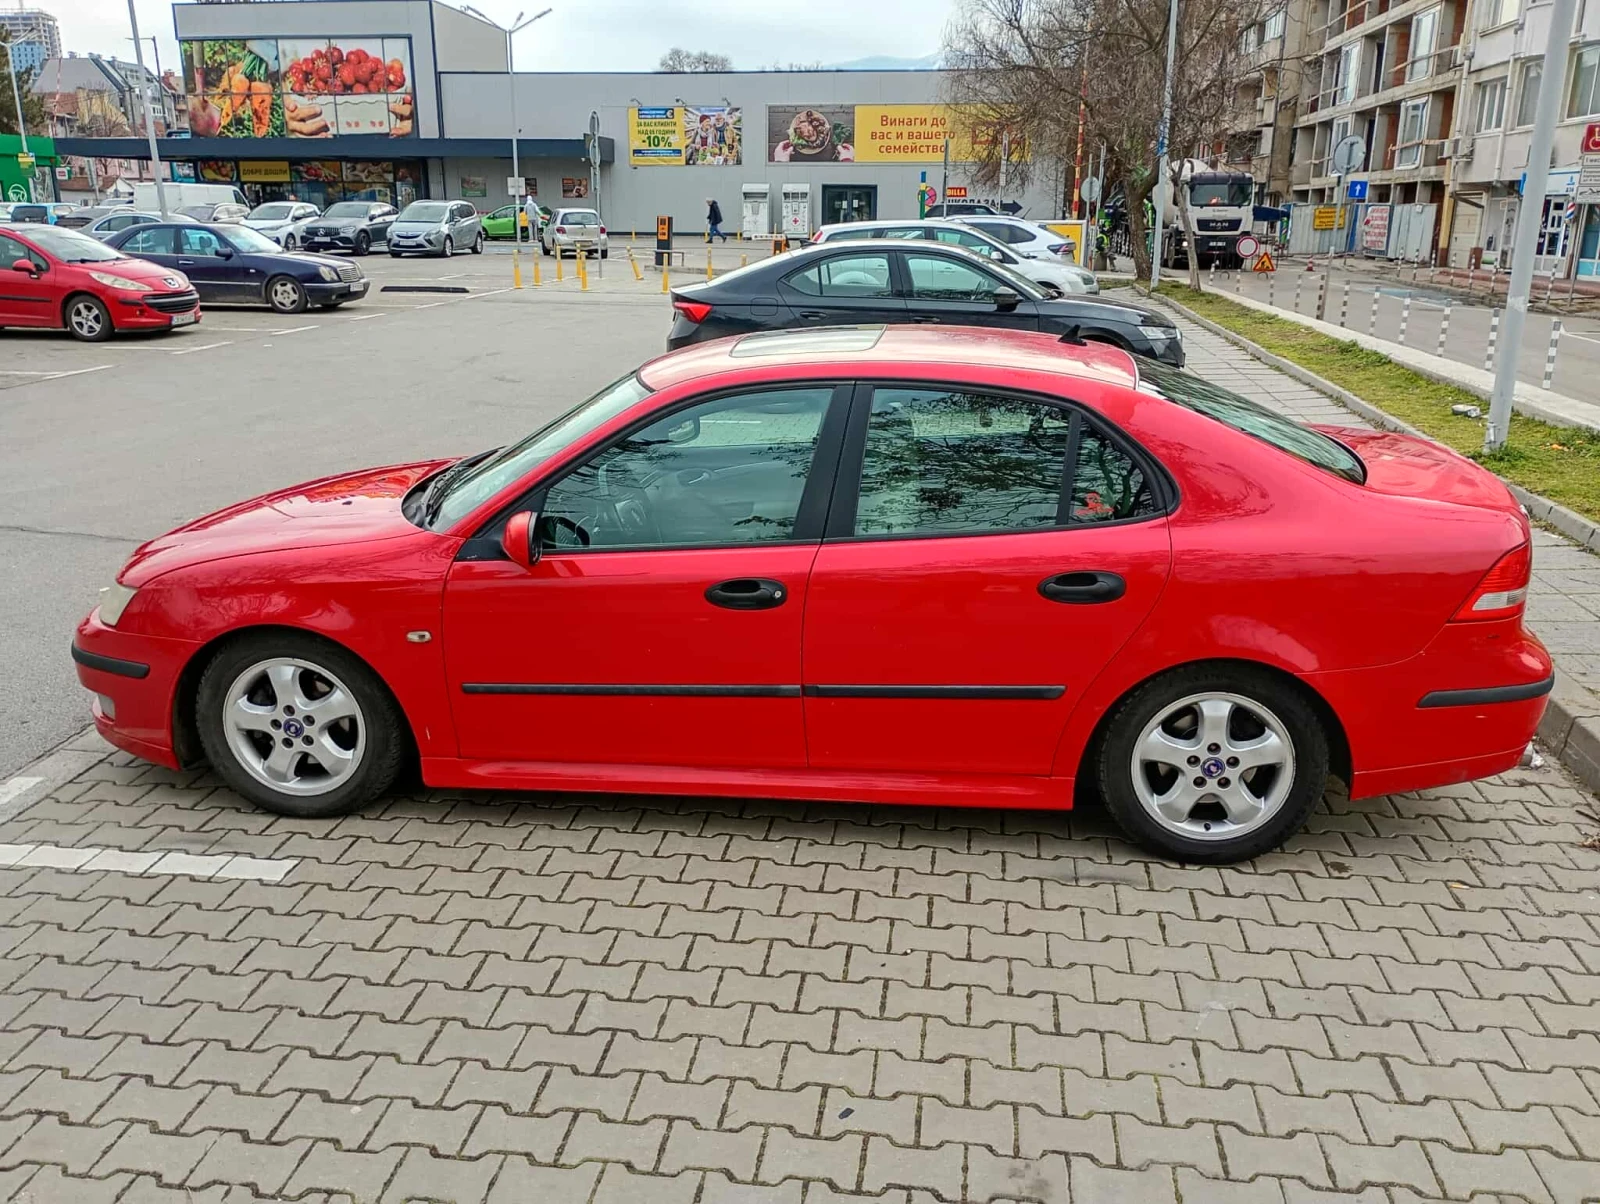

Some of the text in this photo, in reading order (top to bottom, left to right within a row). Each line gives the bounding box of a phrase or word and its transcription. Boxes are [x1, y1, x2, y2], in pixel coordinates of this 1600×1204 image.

[880, 115, 946, 129] Винаги до
[870, 129, 956, 140] вас и вашето
[642, 136, 672, 148] -10%
[878, 142, 946, 154] семейство
[946, 188, 966, 196] BILLA
